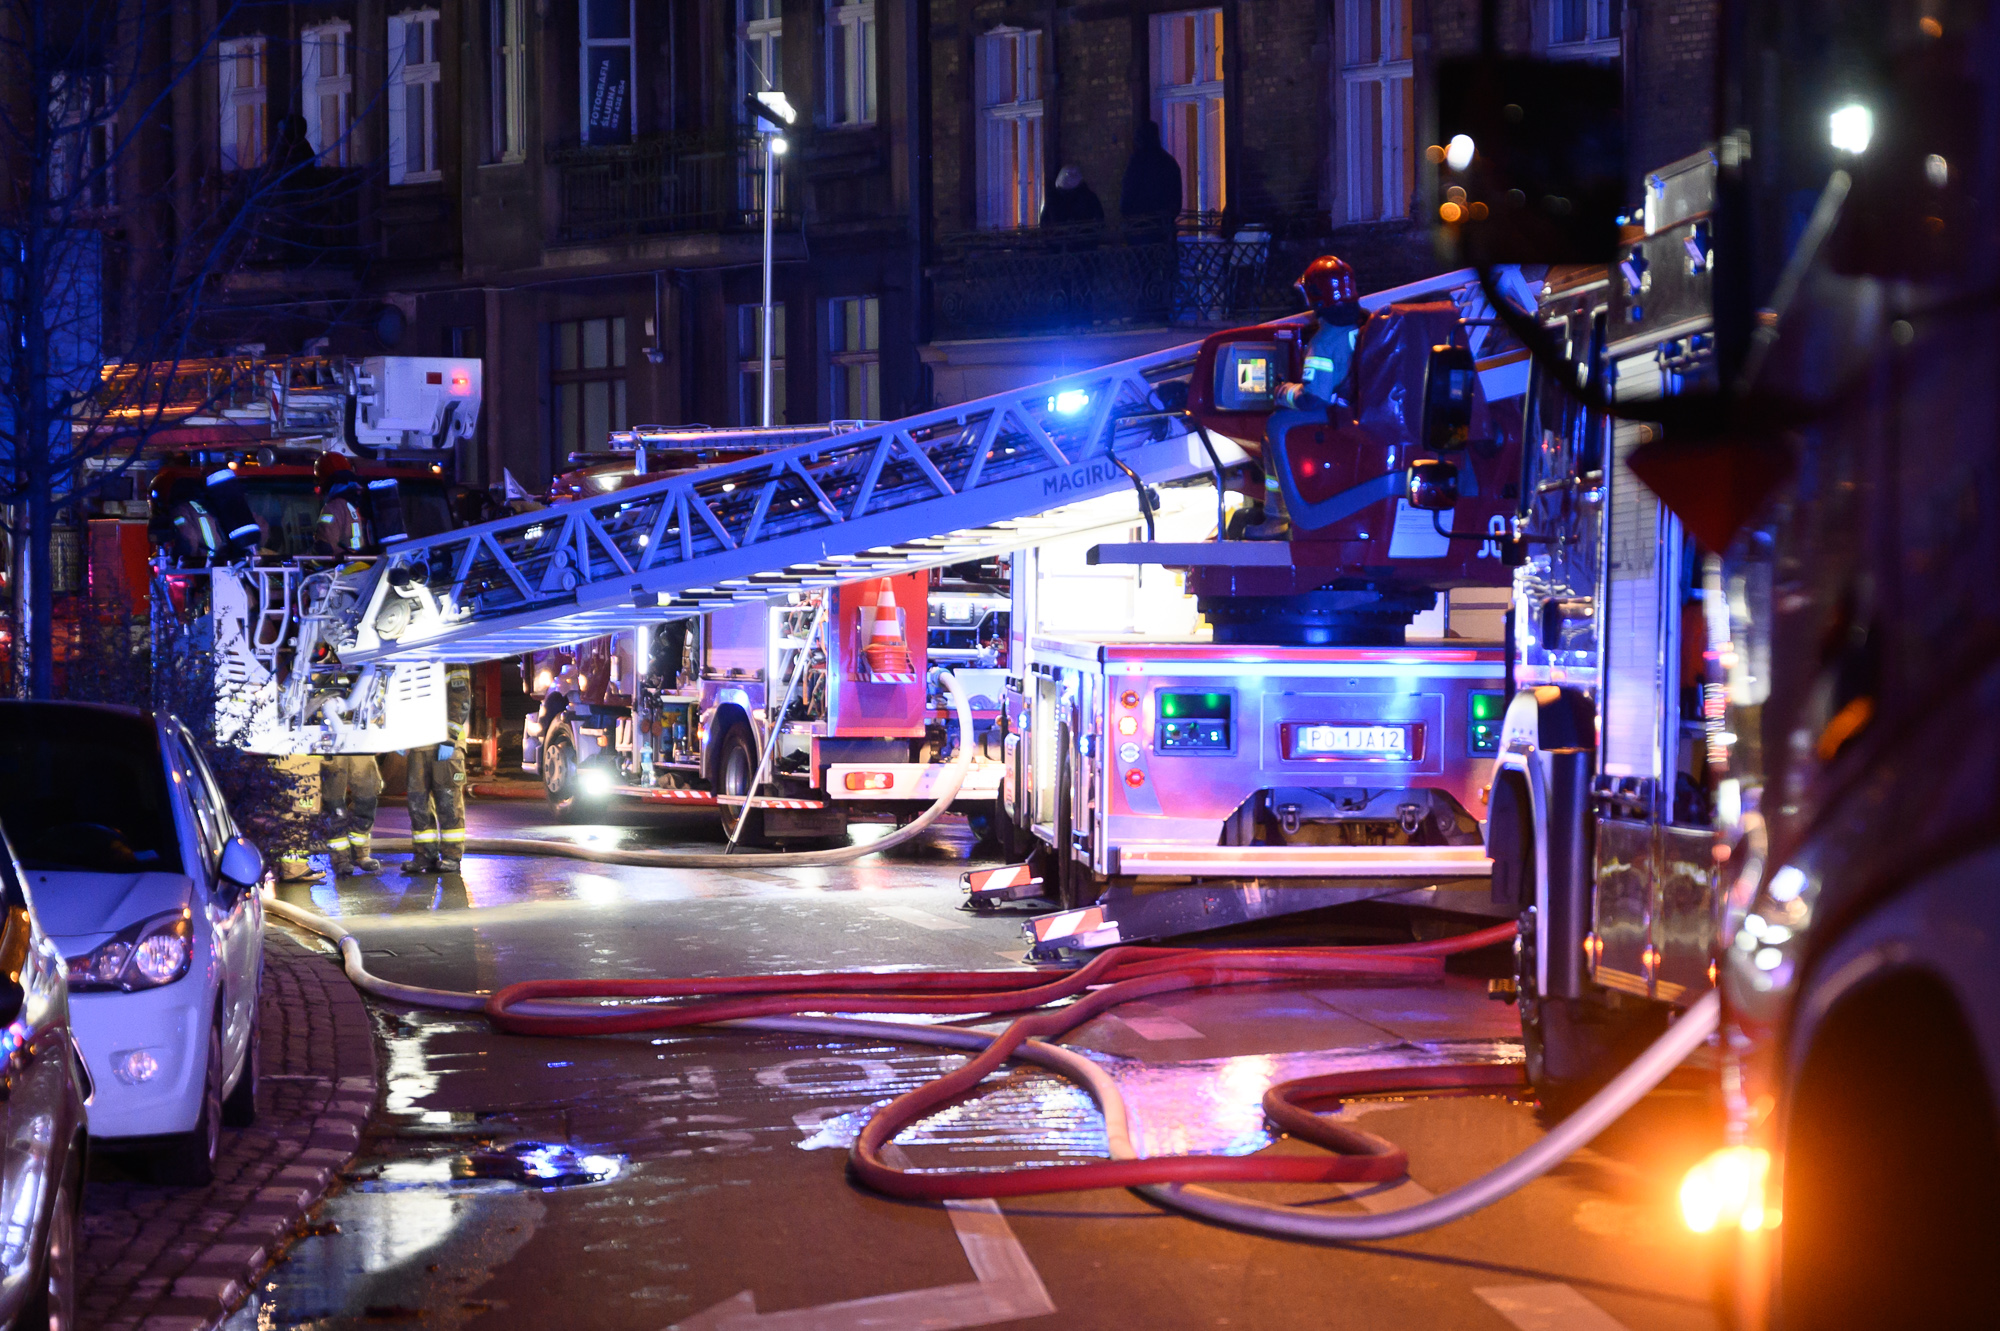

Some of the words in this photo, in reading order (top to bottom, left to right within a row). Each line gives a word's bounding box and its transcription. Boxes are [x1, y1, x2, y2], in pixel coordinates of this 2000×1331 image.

[591, 60, 610, 126] FOTOGRAFIA
[601, 85, 616, 127] ŚLUBNA
[1311, 731, 1335, 748] PO
[1344, 731, 1399, 748] 1JA12
